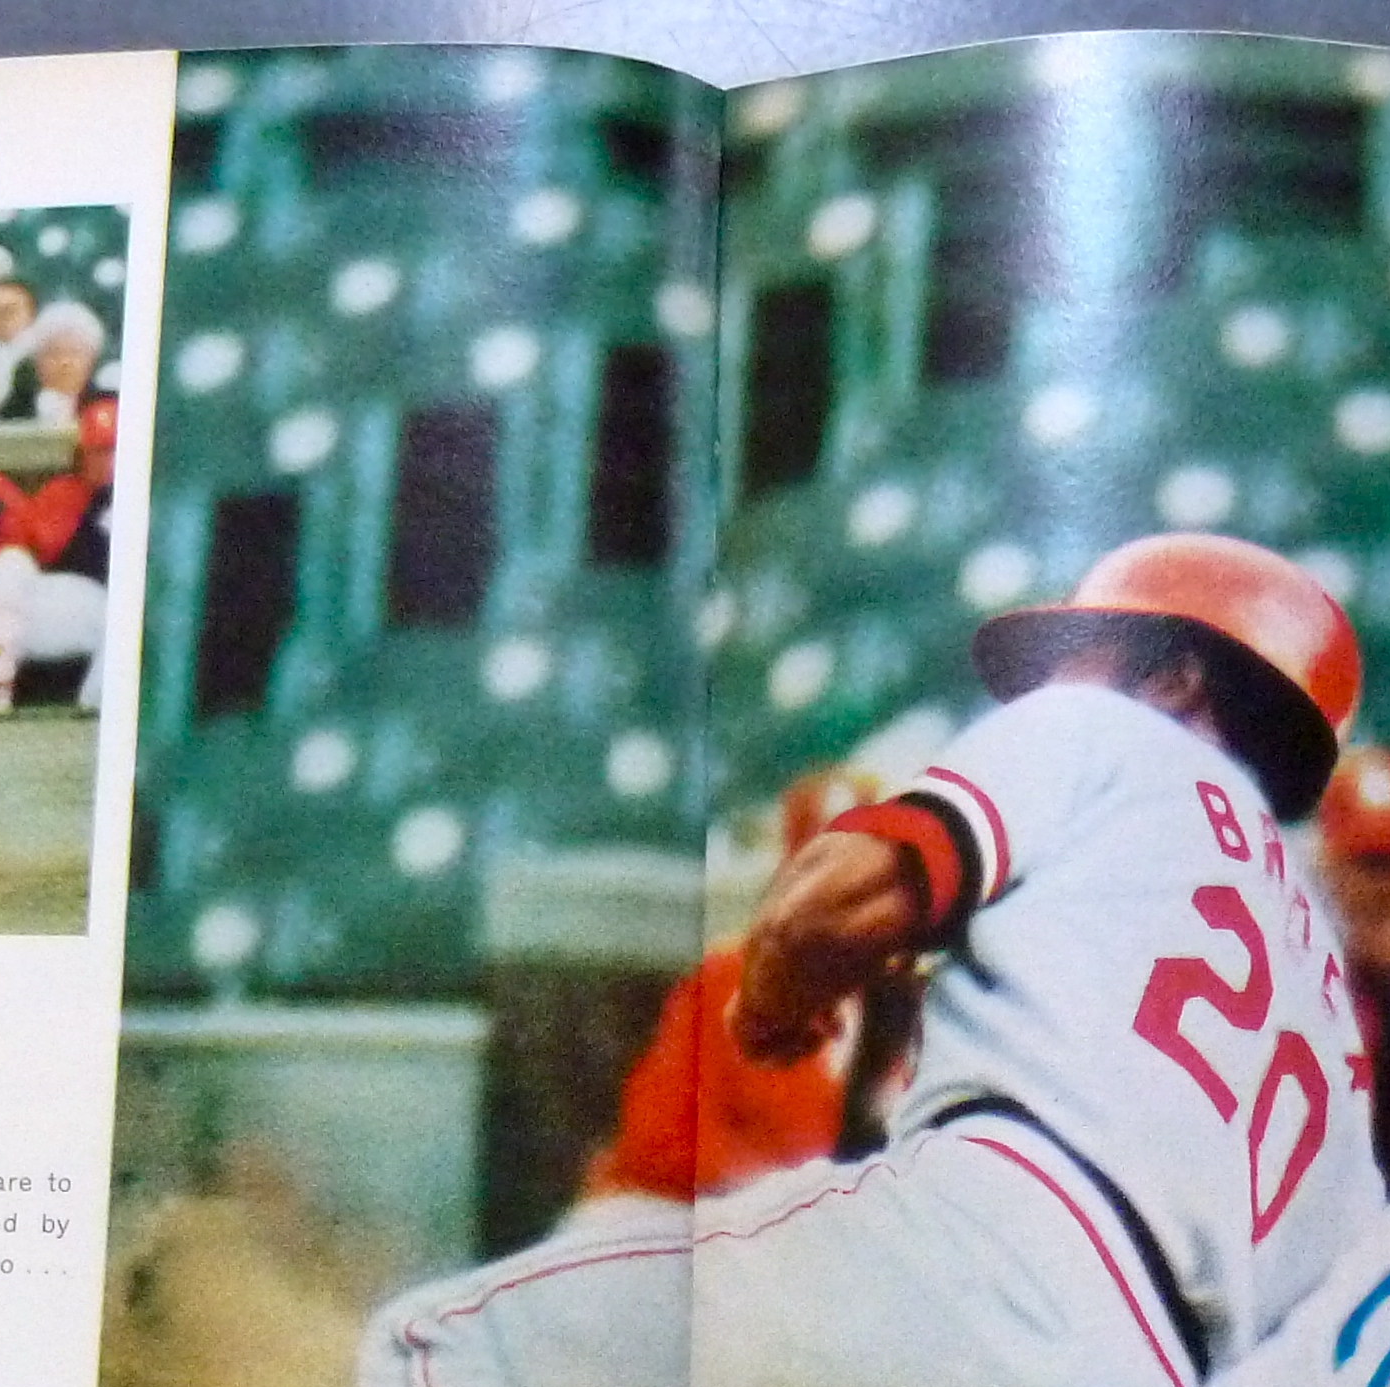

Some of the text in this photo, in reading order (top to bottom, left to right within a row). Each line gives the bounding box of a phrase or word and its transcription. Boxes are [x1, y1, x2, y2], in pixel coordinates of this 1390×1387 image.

[1133, 886, 1329, 1245] 20
[47, 1172, 72, 1193] to
[41, 1212, 71, 1240] by
